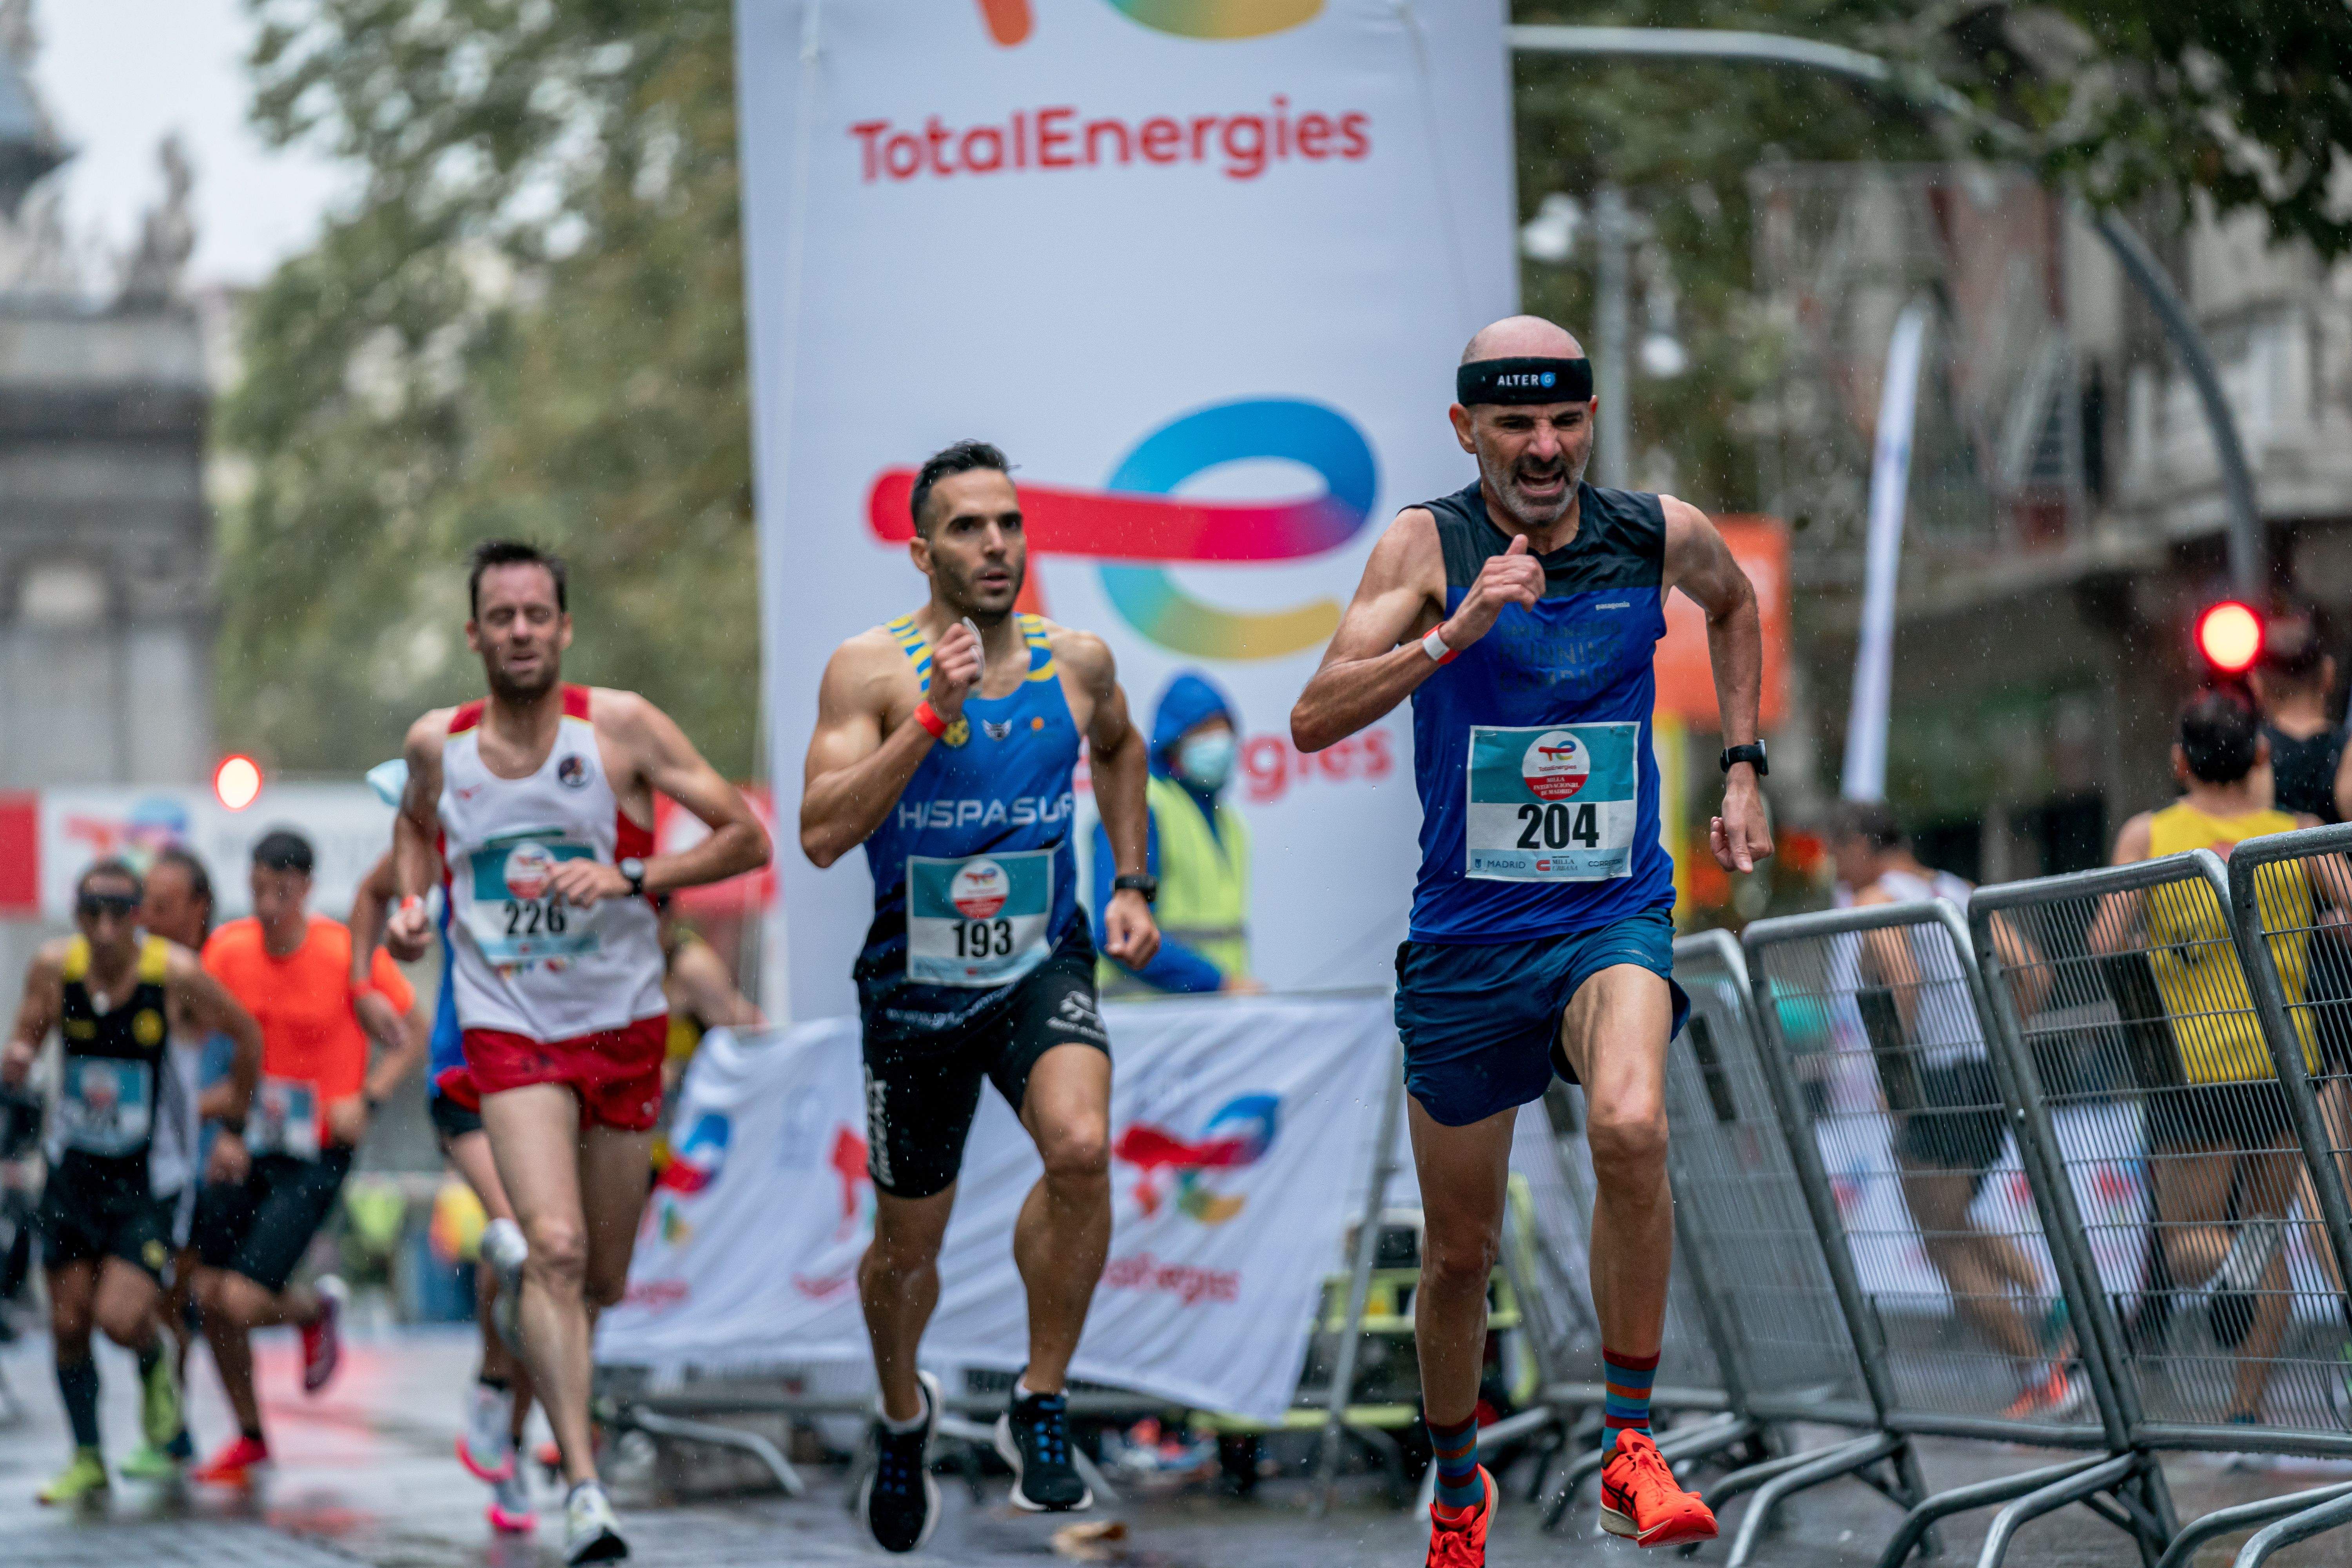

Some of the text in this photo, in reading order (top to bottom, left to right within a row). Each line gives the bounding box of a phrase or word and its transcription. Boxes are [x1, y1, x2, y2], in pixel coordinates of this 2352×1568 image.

[850, 96, 1370, 182] TotalEnergies
[1500, 641, 1623, 665] RUNNING
[1500, 666, 1623, 692] COMPANY
[1517, 803, 1599, 849] 204
[1487, 860, 1526, 869] MADRID
[504, 901, 566, 935] 226
[953, 919, 1011, 958] 193
